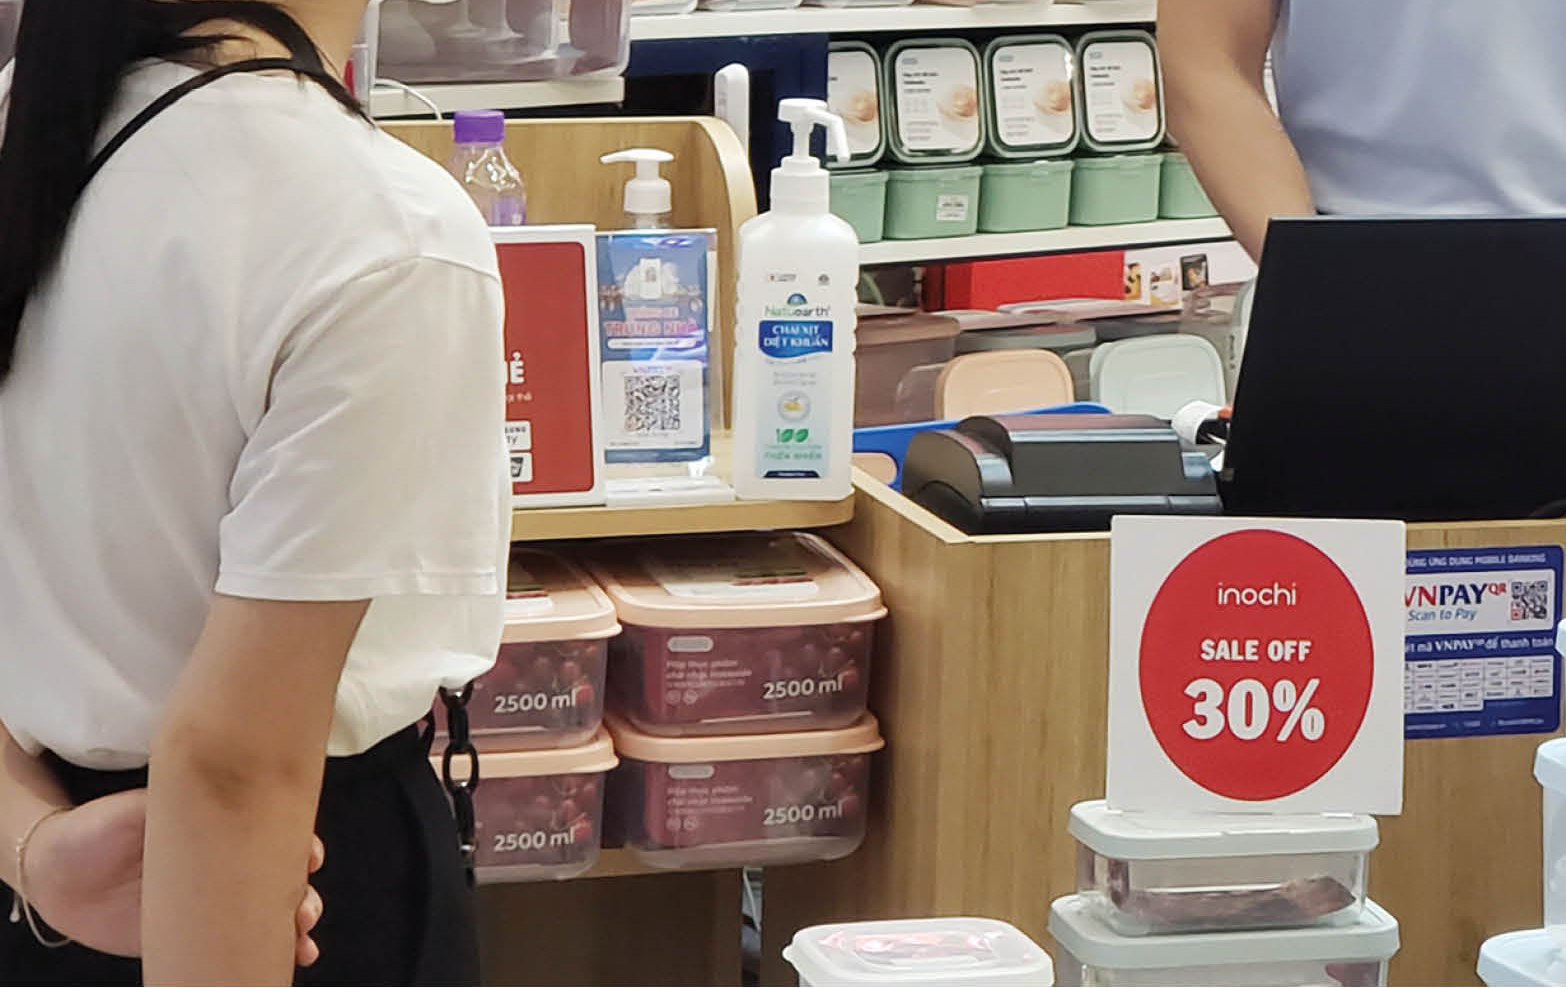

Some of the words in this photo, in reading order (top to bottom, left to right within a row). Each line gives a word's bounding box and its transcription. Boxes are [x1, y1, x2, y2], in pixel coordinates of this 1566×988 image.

[1218, 581, 1297, 605] inochi
[1408, 609, 1436, 621] Scan
[1439, 609, 1452, 620] to
[1455, 608, 1477, 621] Pay
[1200, 639, 1259, 661] SALE
[1267, 639, 1312, 662] OFF
[763, 678, 814, 699] 2500
[818, 674, 843, 694] ml
[494, 693, 547, 712] 2500
[551, 690, 576, 709] ml
[1182, 678, 1326, 742] 30%
[763, 804, 814, 825] 2500
[818, 799, 843, 819] ml
[494, 831, 546, 851] 2500
[550, 826, 575, 846] ml
